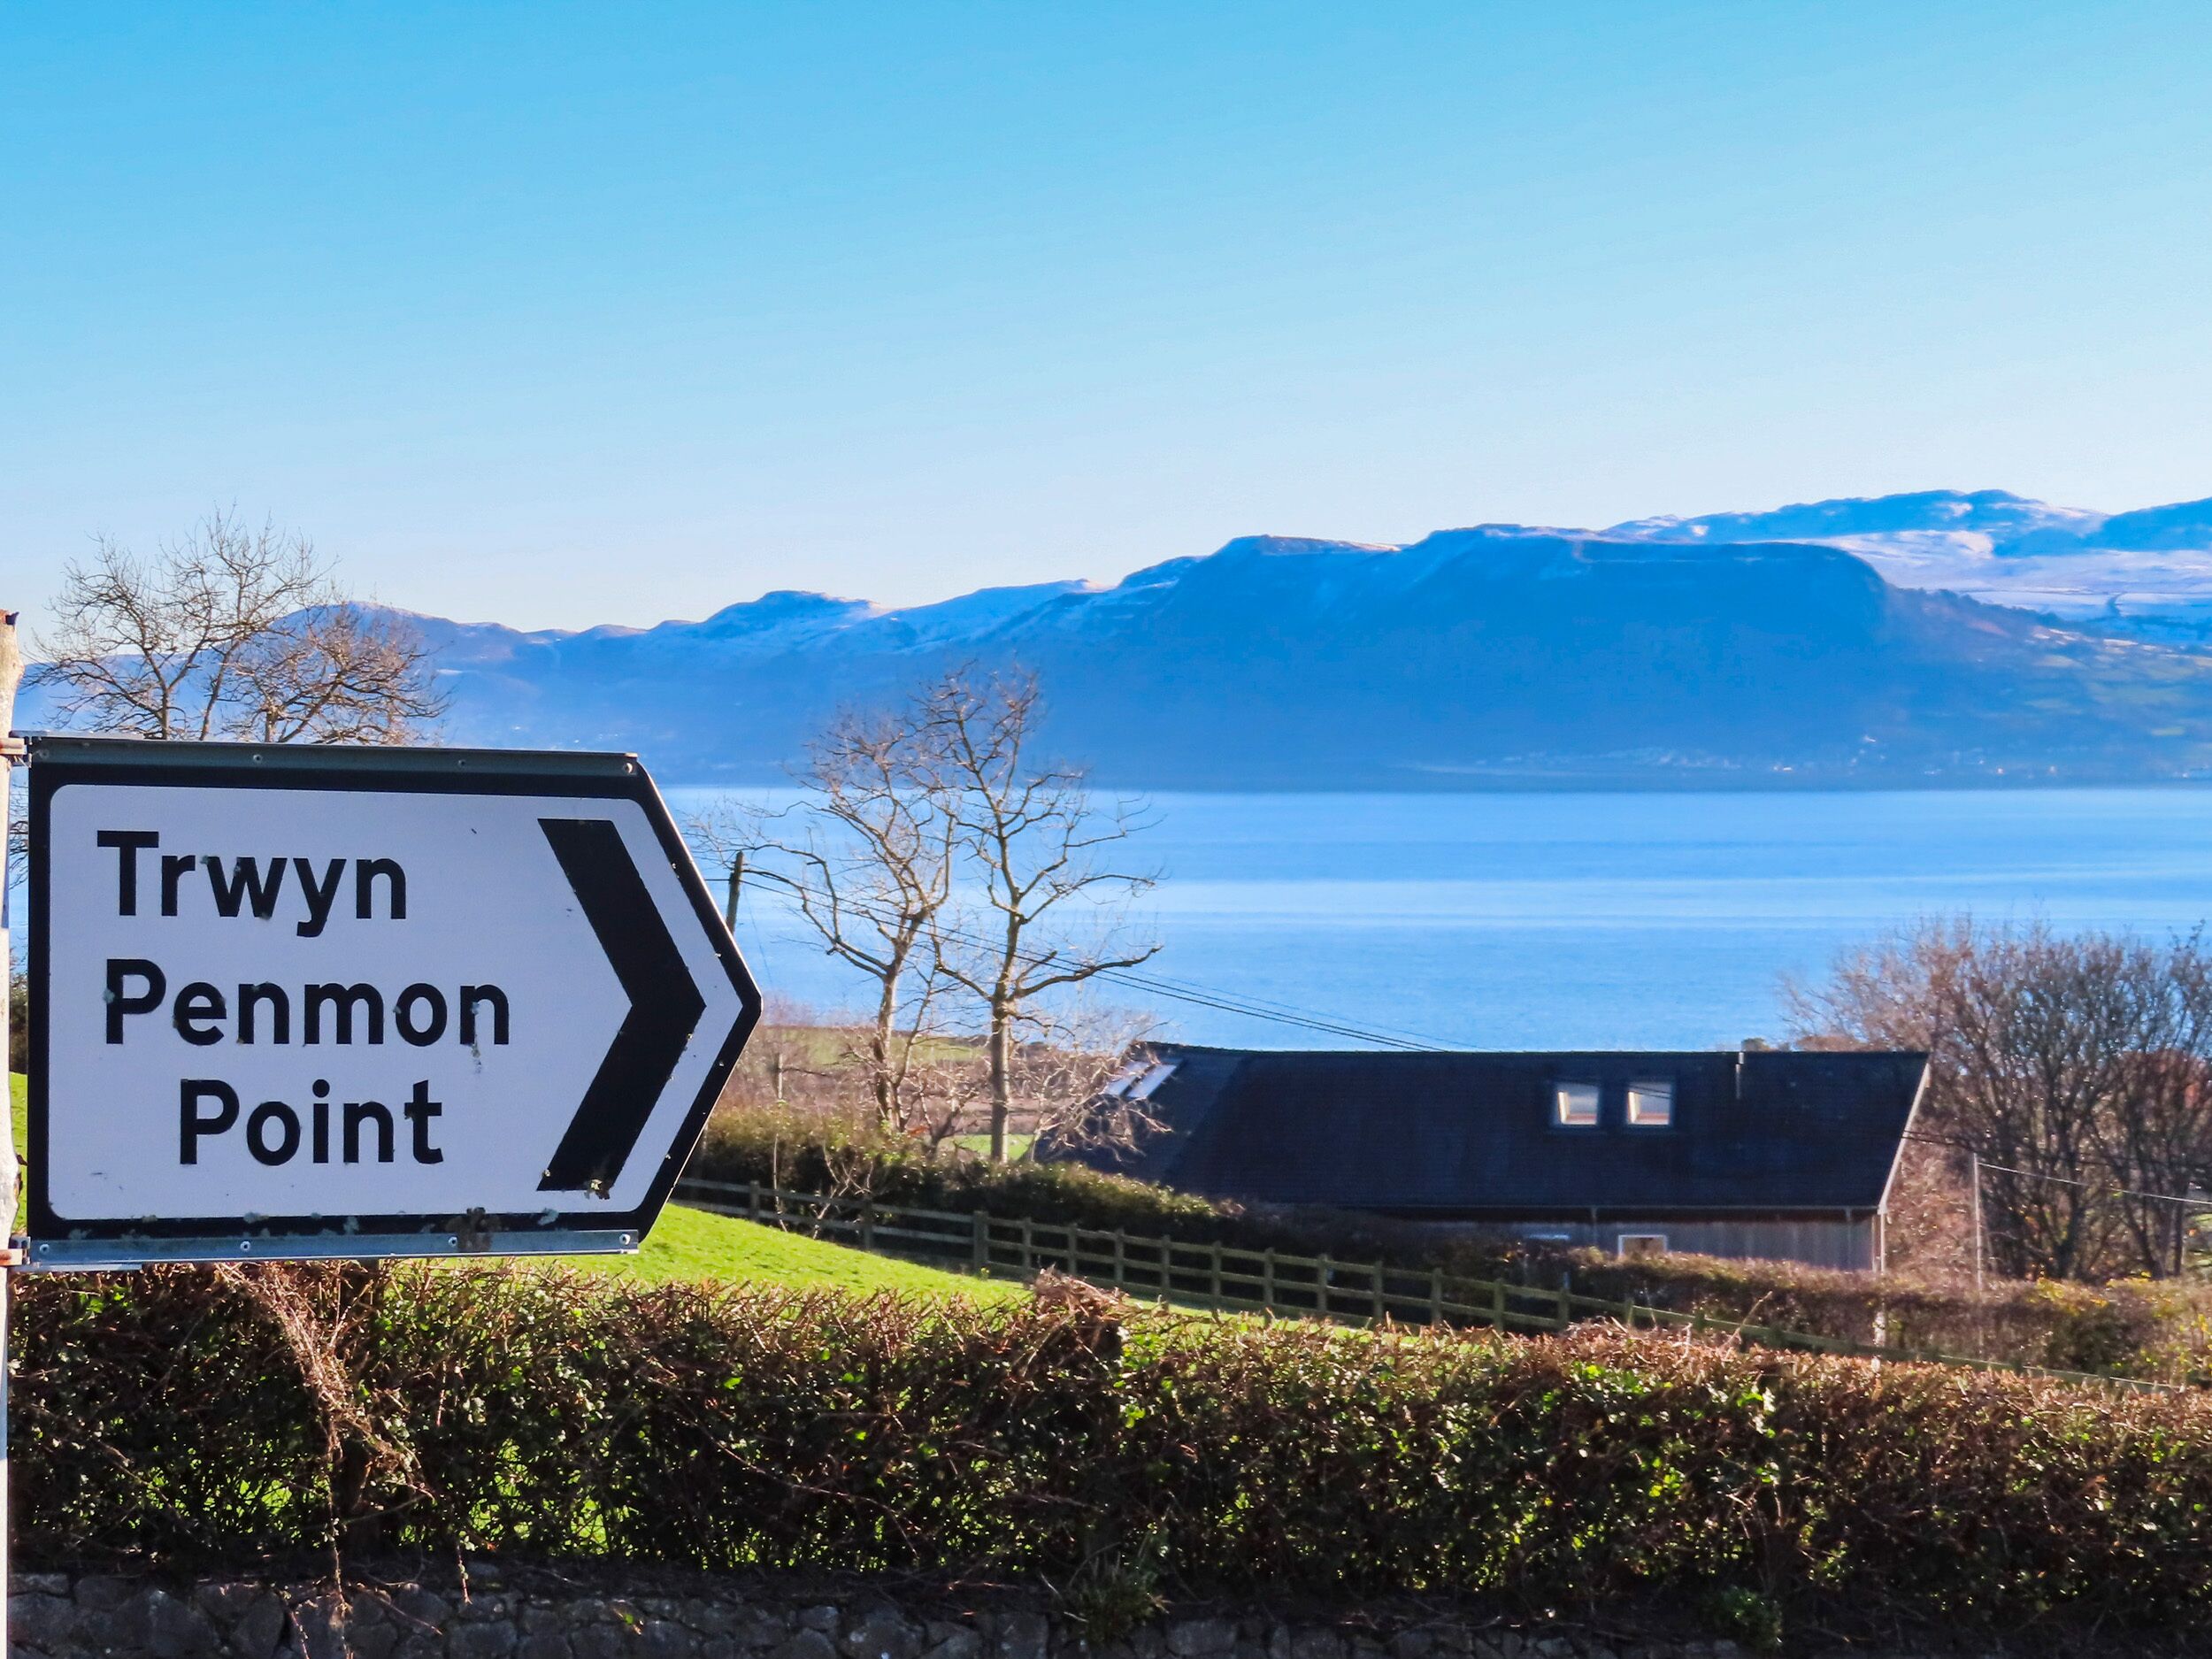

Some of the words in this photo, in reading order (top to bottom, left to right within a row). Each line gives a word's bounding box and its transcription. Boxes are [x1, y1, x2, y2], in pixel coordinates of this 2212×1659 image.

[96, 830, 407, 938] Trwyn
[104, 959, 510, 1048] Penmon
[180, 1079, 444, 1166] Point
